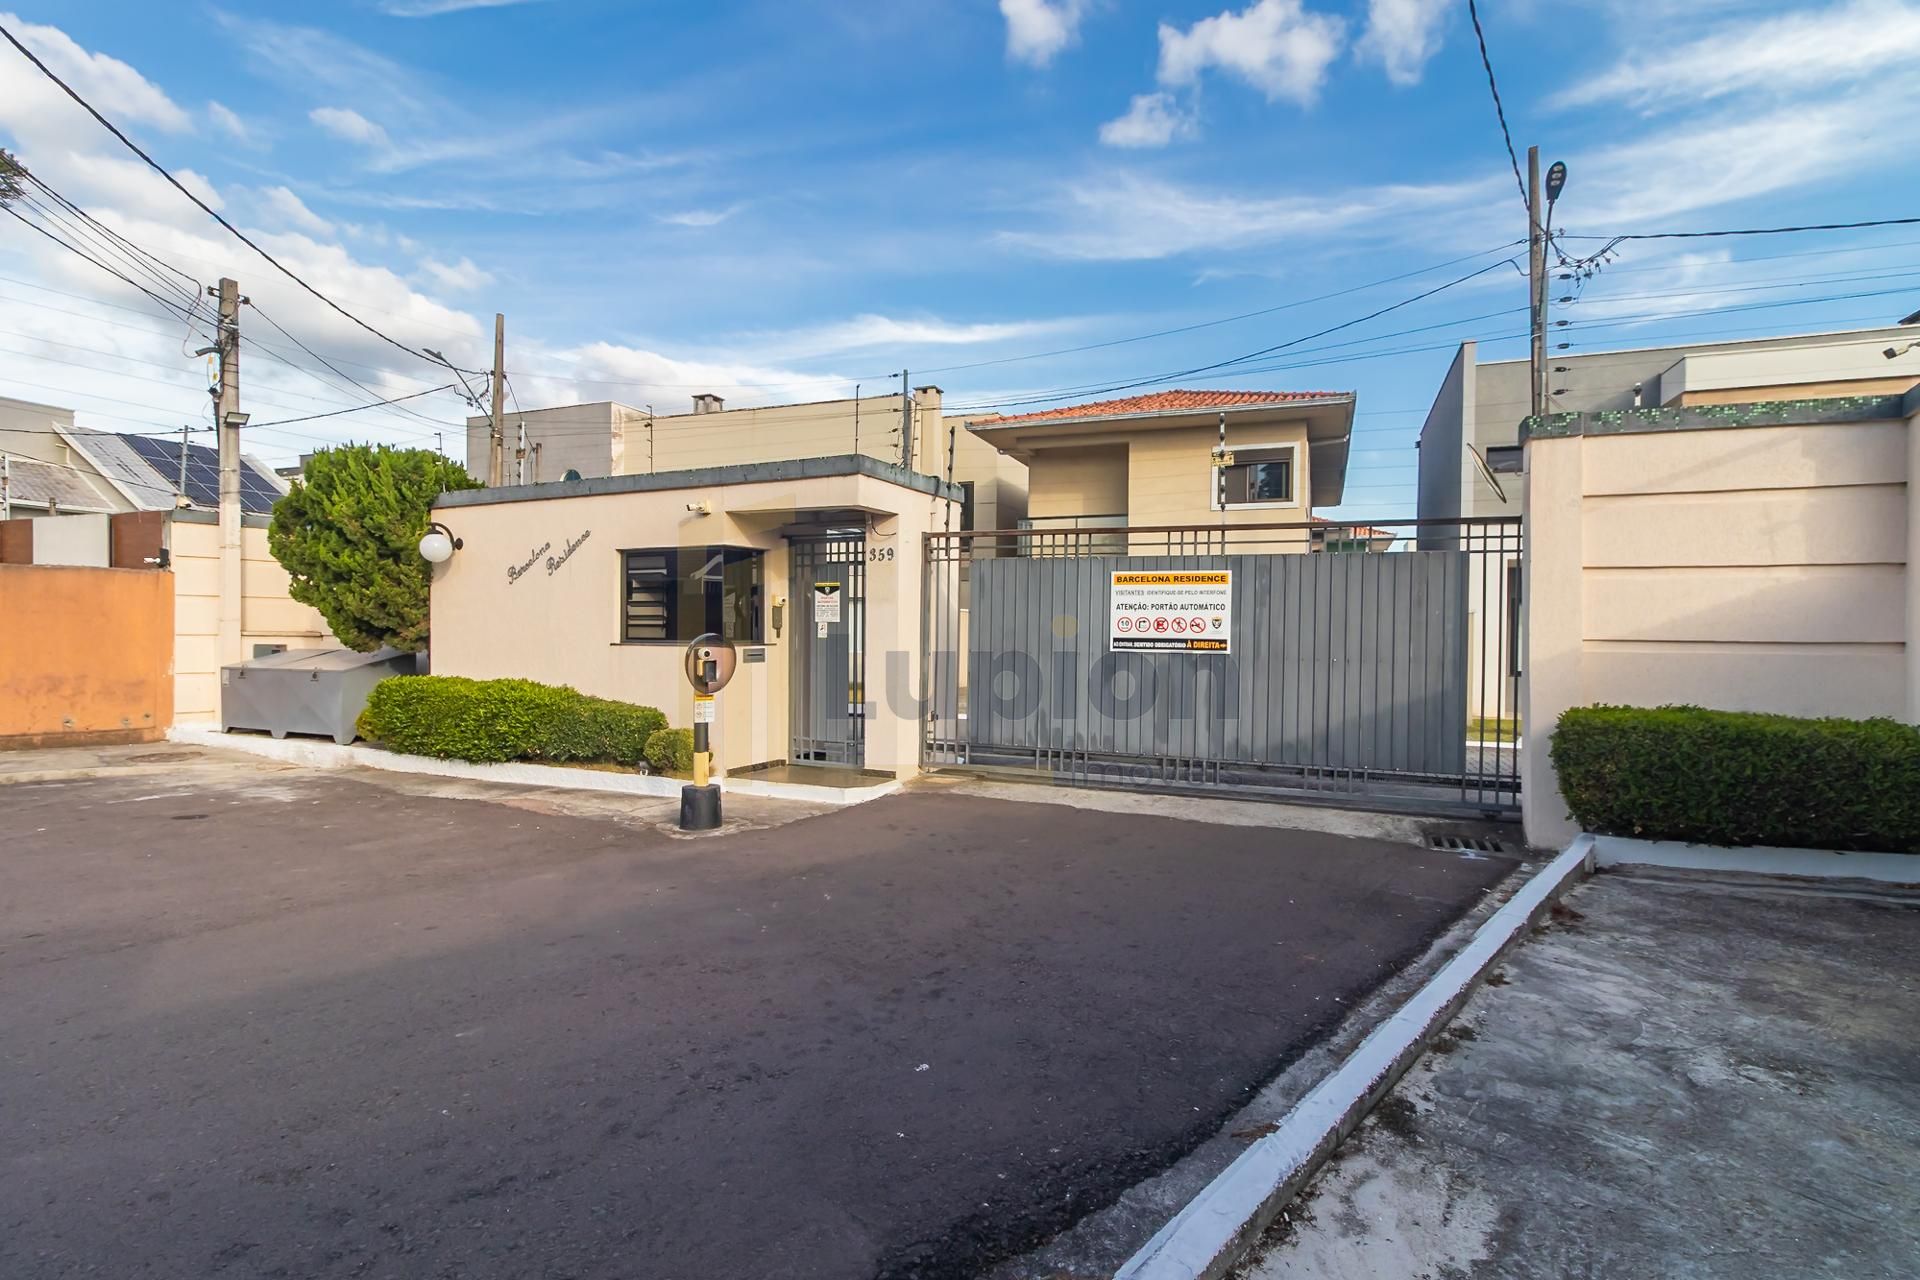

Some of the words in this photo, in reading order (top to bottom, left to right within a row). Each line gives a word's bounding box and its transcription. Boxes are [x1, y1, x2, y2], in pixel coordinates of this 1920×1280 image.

[869, 547, 895, 562] 359
[1116, 575, 1171, 583] BARCELONA
[1173, 574, 1227, 583] RESIDENCE
[1115, 602, 1150, 612] ATENÇÃO:
[1150, 602, 1179, 611] PORTÃO
[1193, 641, 1221, 649] DIREITA
